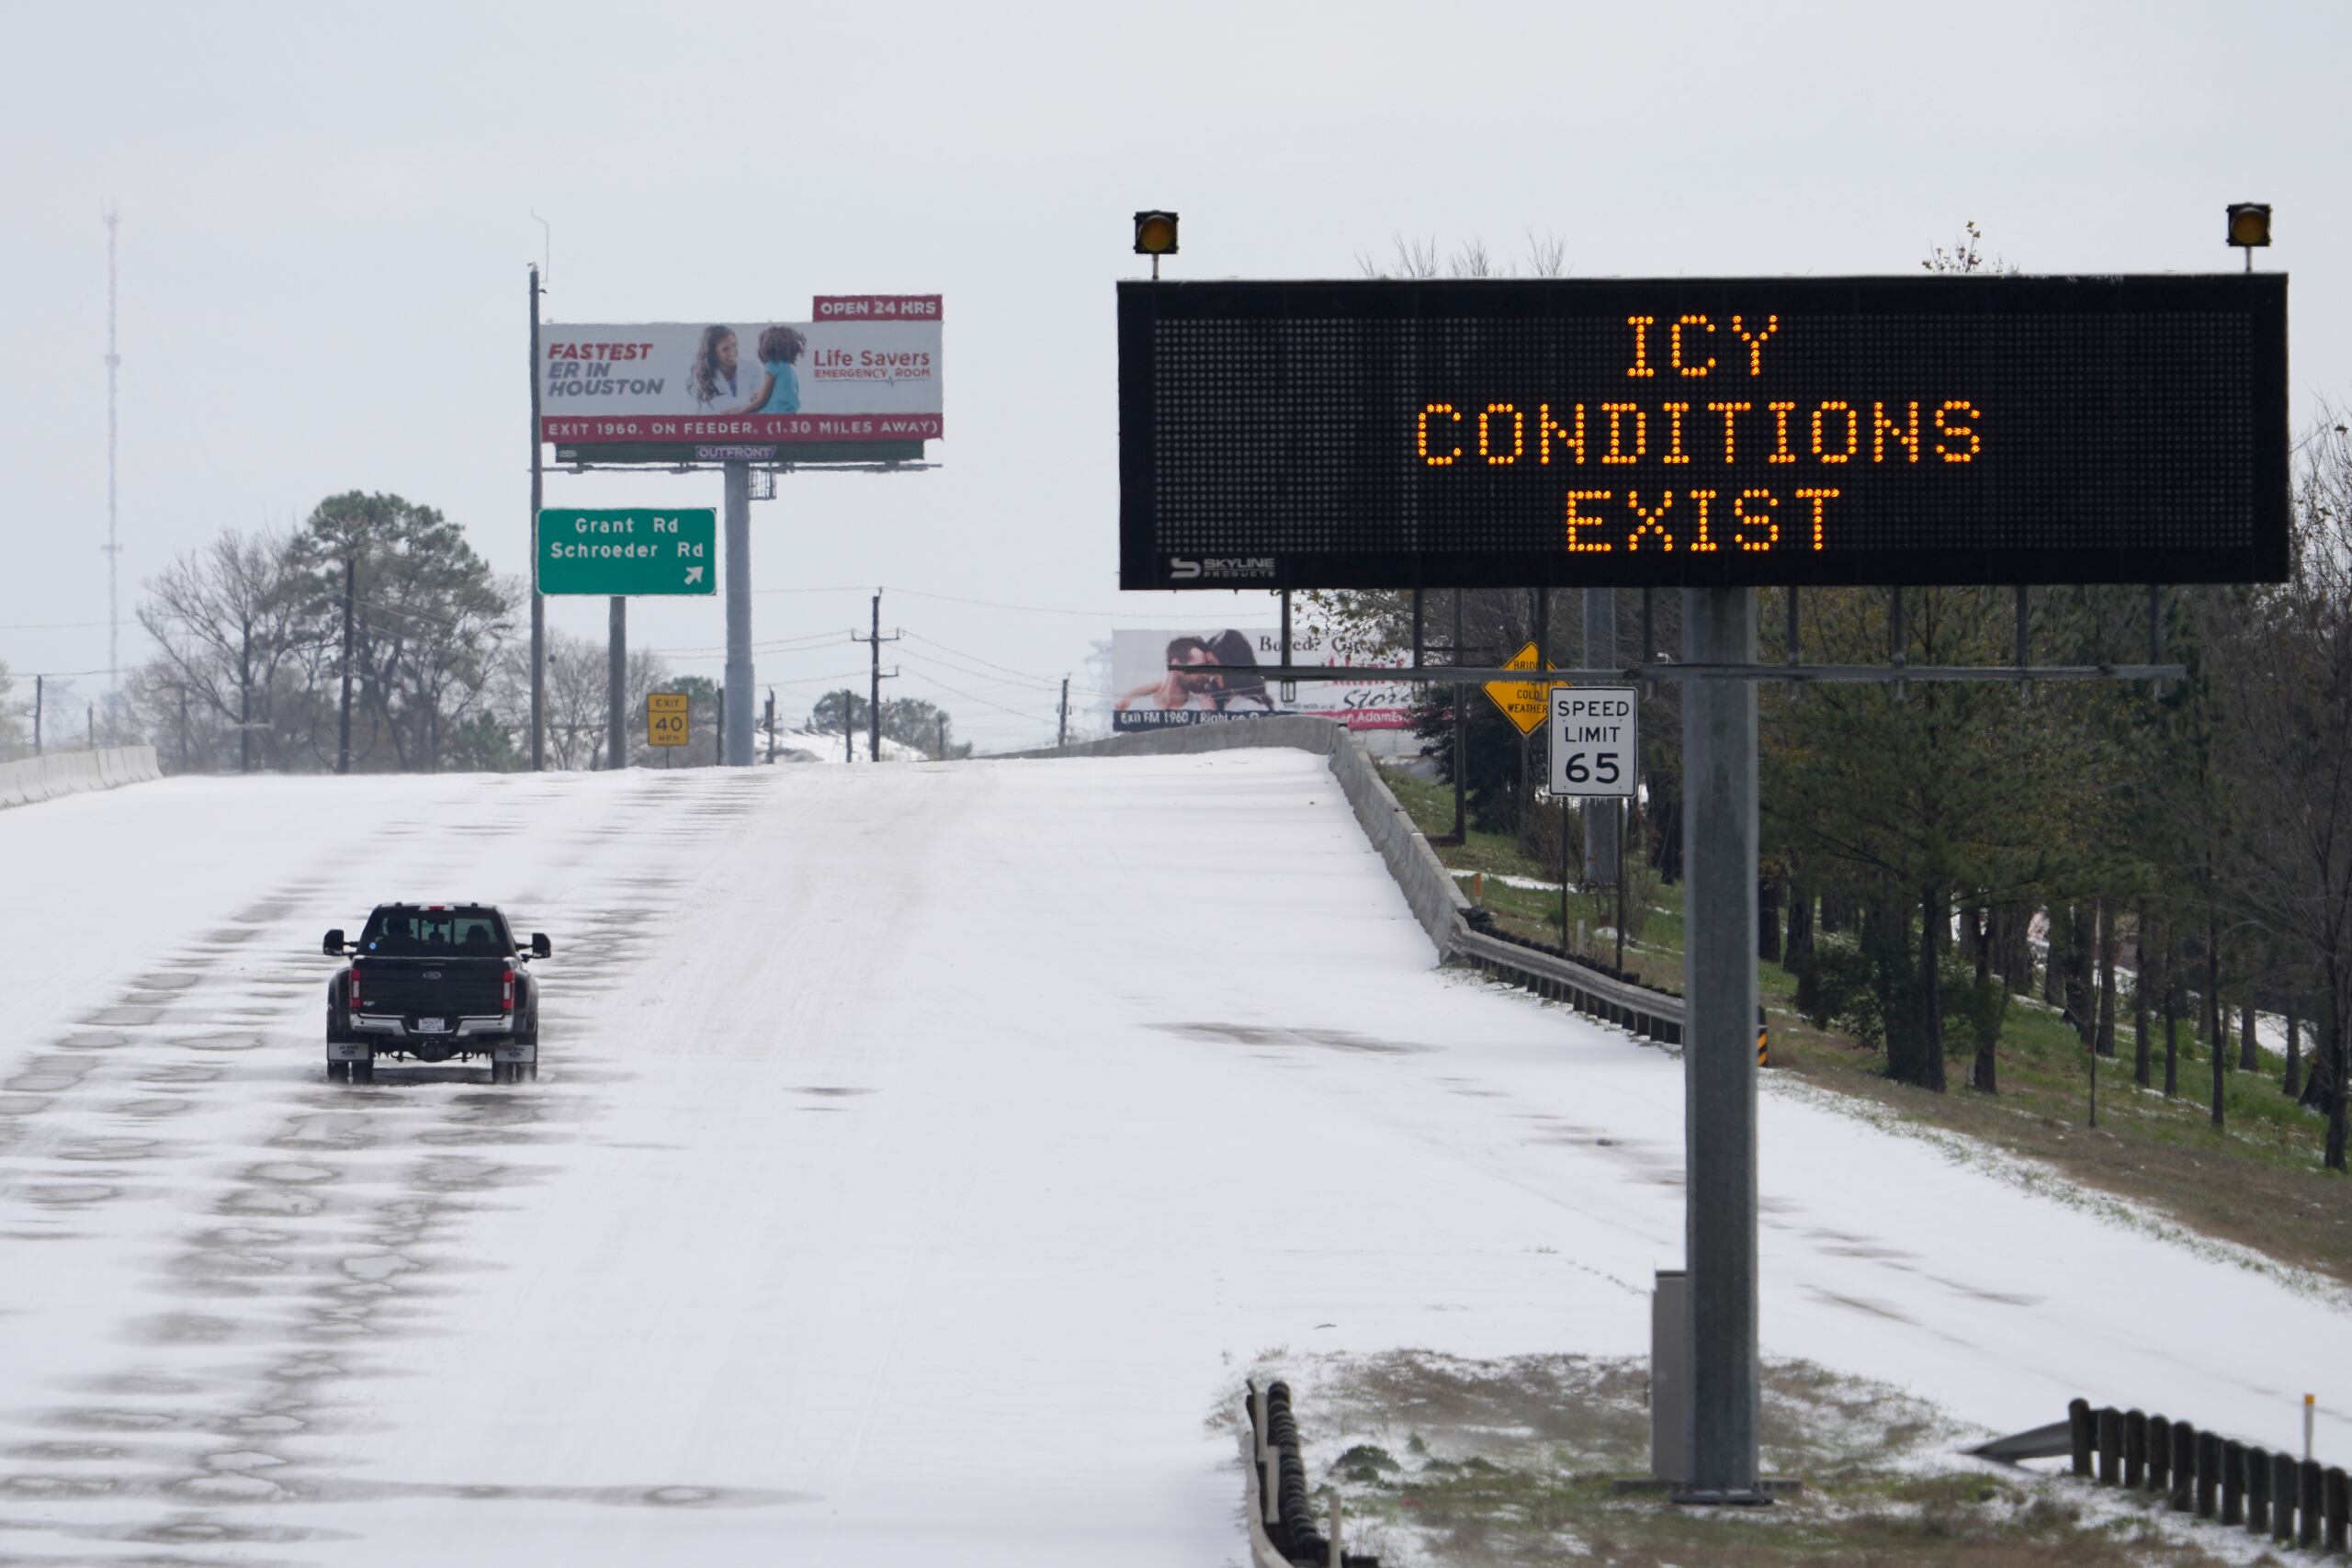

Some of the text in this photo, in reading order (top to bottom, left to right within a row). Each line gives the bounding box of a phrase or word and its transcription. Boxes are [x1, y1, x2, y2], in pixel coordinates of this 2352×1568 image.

[820, 301, 937, 316] OPEN 24 HRS
[547, 343, 653, 361] FASTEST
[1625, 313, 1780, 378] ICY
[813, 350, 931, 367] Life Savers
[548, 362, 610, 379] ER IN
[813, 367, 932, 379] EMERGENCY ROOM
[548, 378, 665, 397] HOUSTON
[548, 423, 589, 436] EXIT
[652, 423, 676, 435] ON
[766, 421, 812, 435] (1.30
[820, 422, 873, 434] MILES
[879, 421, 938, 434] AWAY)
[1416, 401, 1984, 467] CONDITIONS
[698, 446, 773, 459] OUTFRONT
[575, 517, 679, 534] Grant Rd
[1566, 488, 1842, 554] EXIST
[550, 542, 705, 558] Schroeder Rd
[1203, 558, 1276, 568] SKYLINE
[1260, 636, 1321, 652] Boed?
[1513, 661, 1541, 670] BRID
[655, 698, 680, 707] EXIT
[1517, 690, 1540, 700] COLD
[1508, 703, 1548, 714] WEATHER
[1557, 701, 1630, 716] SPEED
[655, 716, 684, 732] 40
[1121, 711, 1141, 724] Exit
[1143, 712, 1159, 723] FM
[1164, 711, 1189, 724] 1960
[1565, 727, 1621, 742] LIMIT
[1565, 752, 1620, 784] 65
